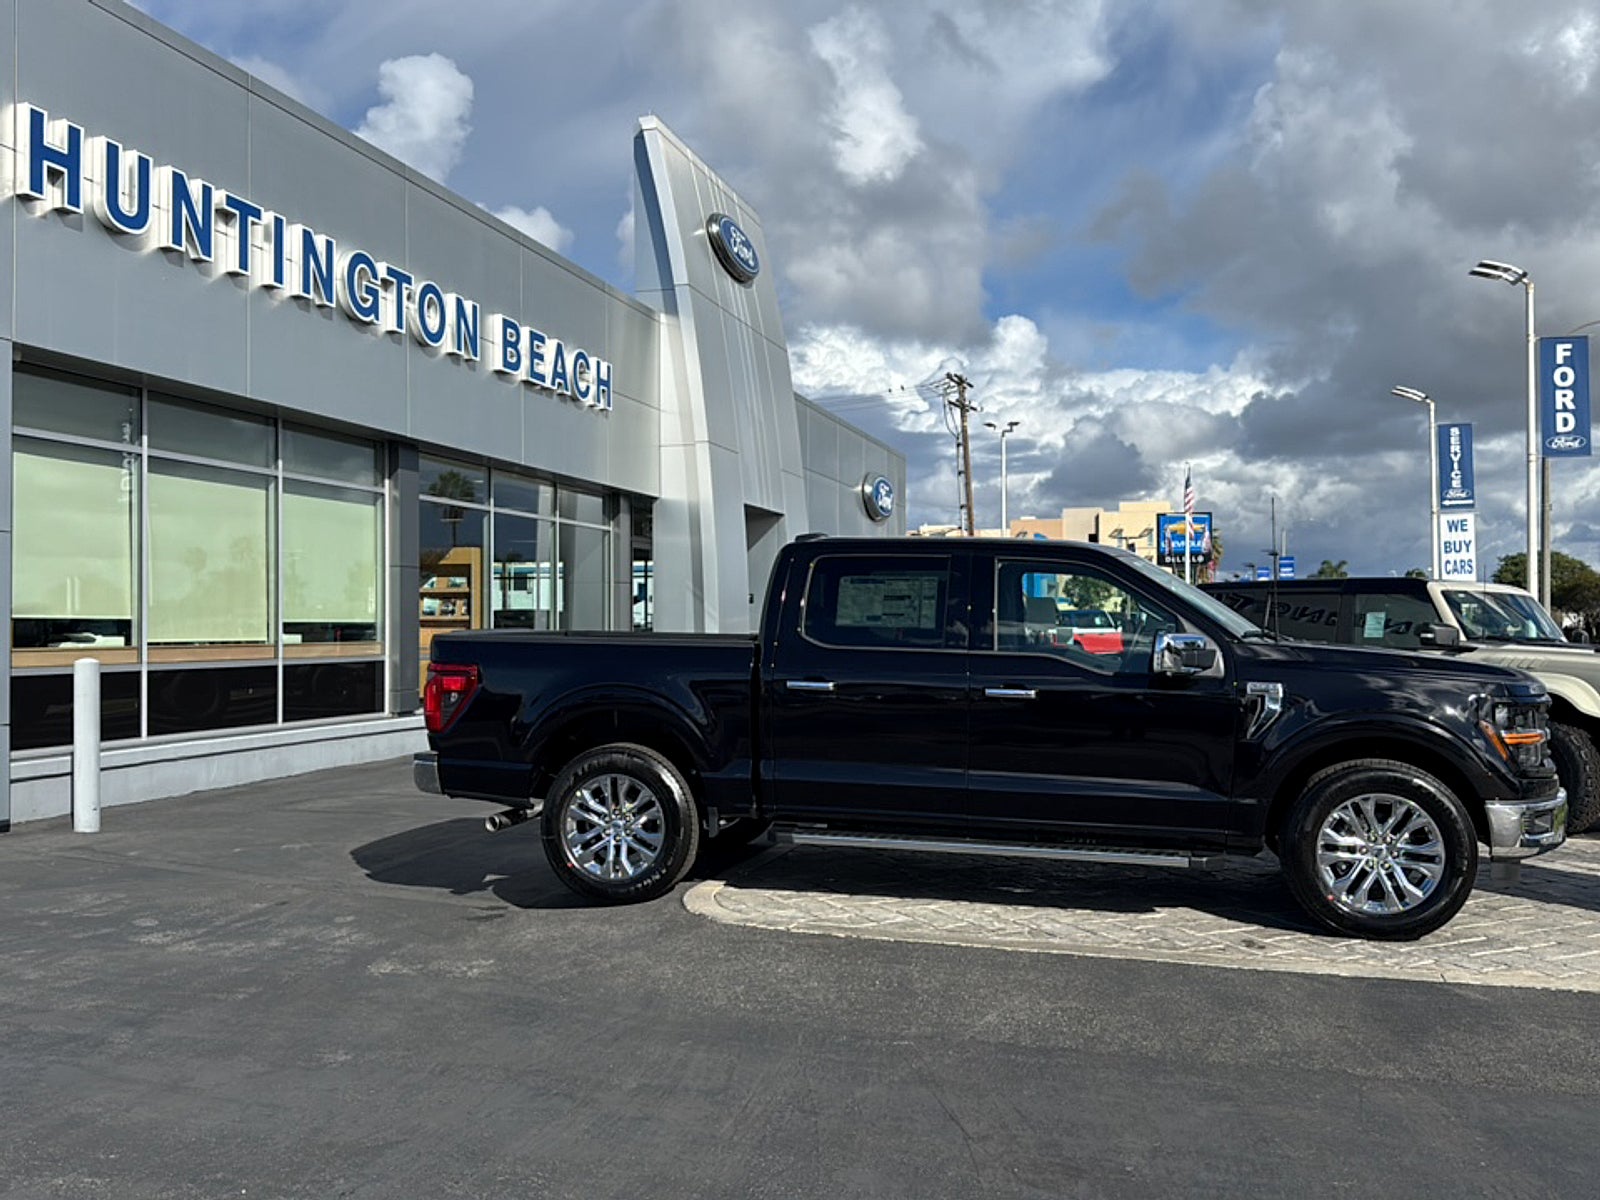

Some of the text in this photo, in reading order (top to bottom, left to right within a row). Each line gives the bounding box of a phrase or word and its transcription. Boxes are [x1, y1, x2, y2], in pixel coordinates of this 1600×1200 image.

[26, 103, 613, 411] HUNTINGTON BEACH
[727, 223, 757, 269] Ford
[1553, 343, 1576, 433] FORD
[1449, 426, 1462, 488] SERVICE
[1548, 436, 1584, 450] Ford
[1446, 518, 1468, 533] WE
[1443, 540, 1473, 555] BUY
[1444, 559, 1474, 575] CARS
